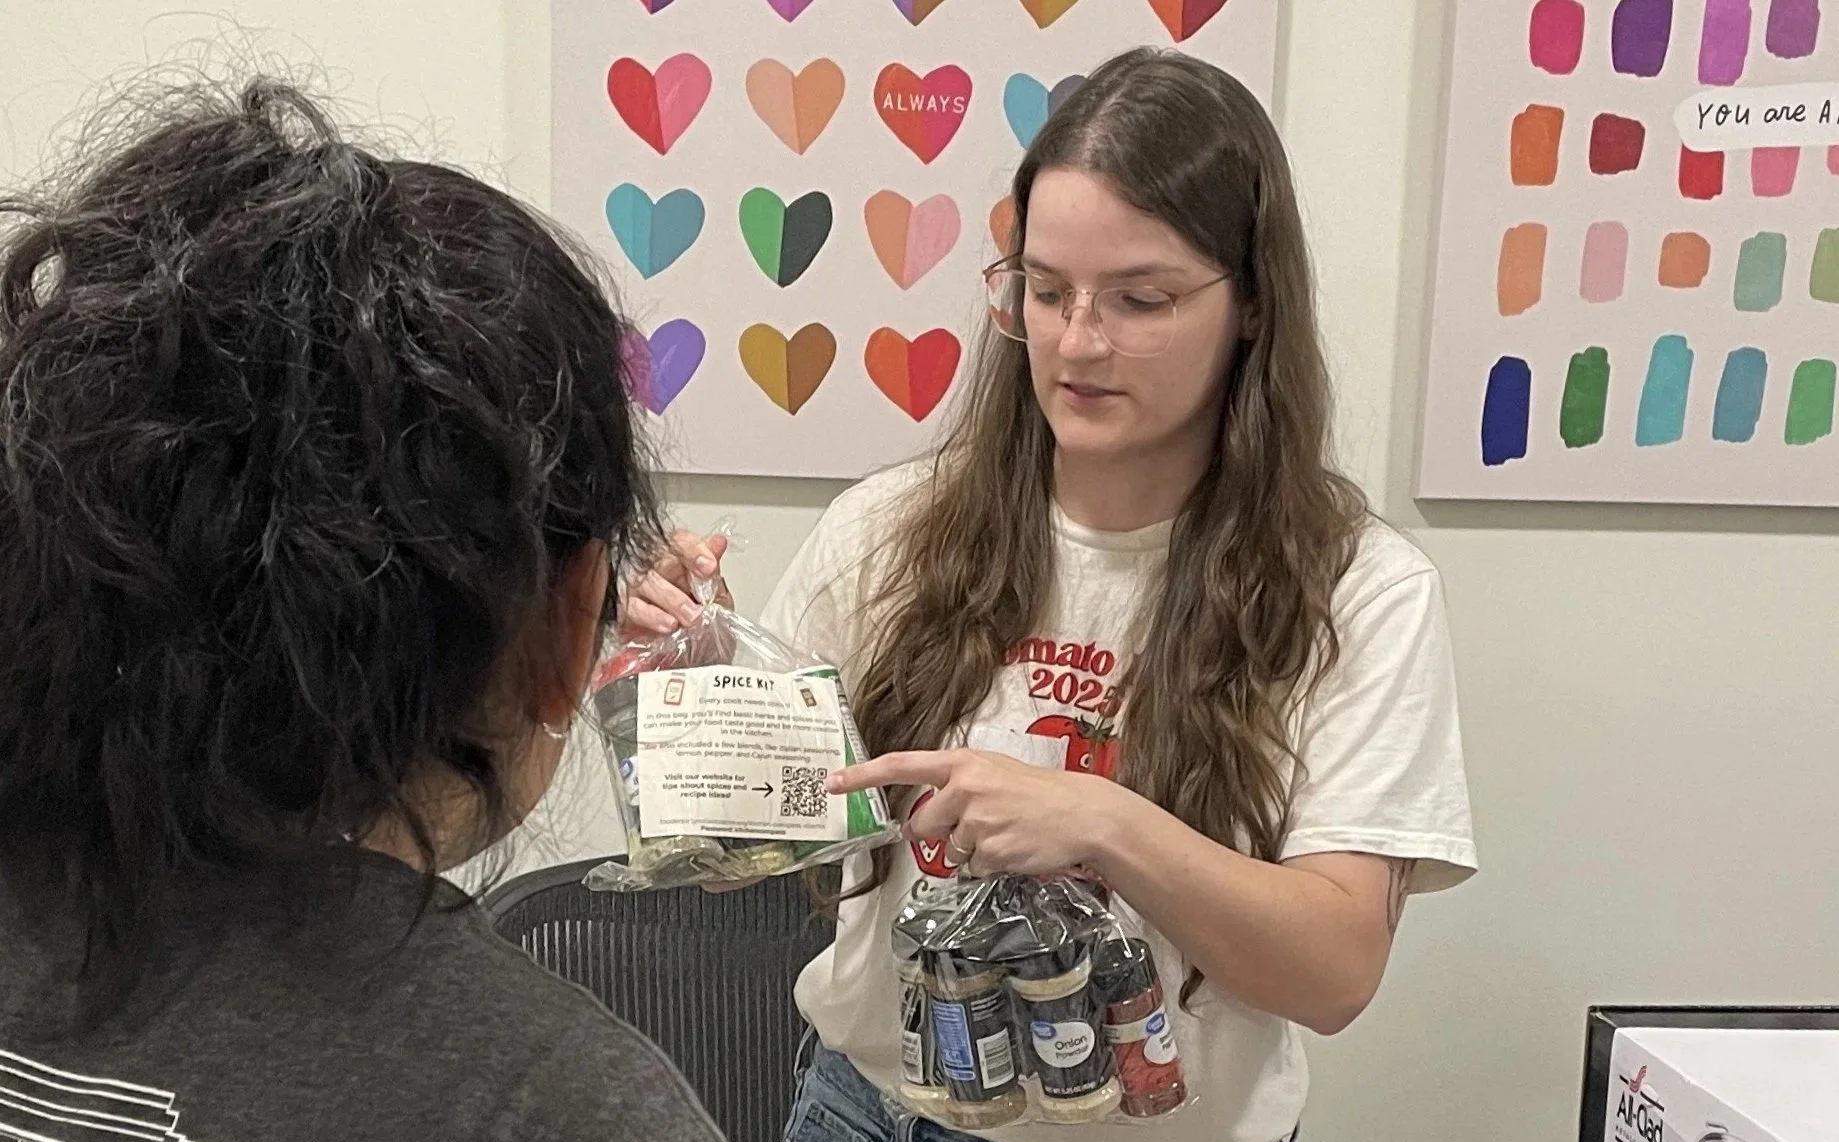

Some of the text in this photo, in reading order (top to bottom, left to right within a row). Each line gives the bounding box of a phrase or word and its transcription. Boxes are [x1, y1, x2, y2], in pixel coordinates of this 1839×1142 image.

[882, 92, 966, 114] ALWAYS
[1763, 103, 1808, 124] are
[1818, 99, 1839, 125] A
[713, 675, 776, 692] SPICE KIT
[714, 710, 732, 718] find
[643, 721, 658, 729] can
[659, 720, 682, 728] make
[684, 719, 702, 728] your
[745, 721, 765, 729] good
[720, 727, 729, 735] in
[729, 728, 743, 736] the
[676, 741, 713, 749] included
[721, 741, 736, 749] few
[664, 773, 683, 781] Visit
[702, 773, 733, 781] website
[662, 782, 678, 790] tips
[680, 790, 707, 799] recipe
[1054, 1034, 1088, 1052] Onion
